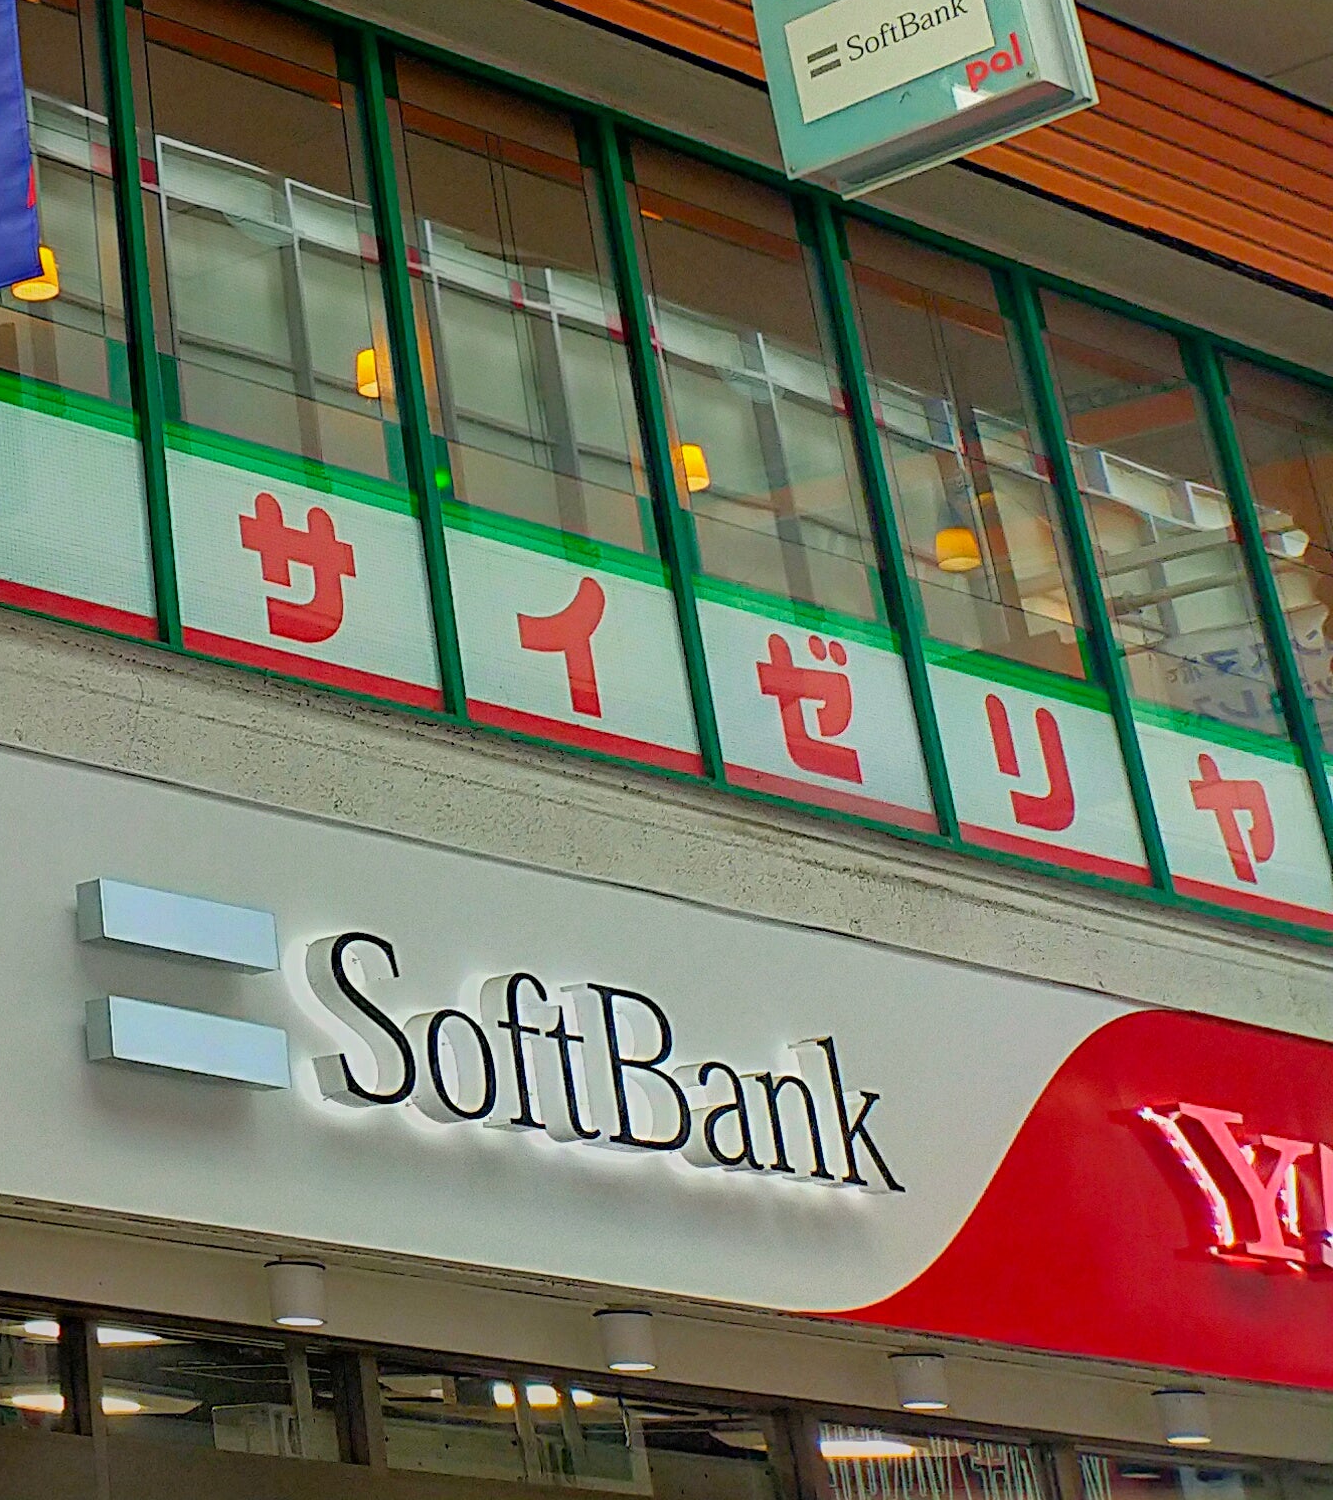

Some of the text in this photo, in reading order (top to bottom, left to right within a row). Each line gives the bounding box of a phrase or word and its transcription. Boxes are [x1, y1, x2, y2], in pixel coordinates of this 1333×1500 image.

[965, 32, 1025, 92] pal
[238, 490, 1276, 886] サイゼリヤ
[330, 931, 906, 1194] SoftBank
